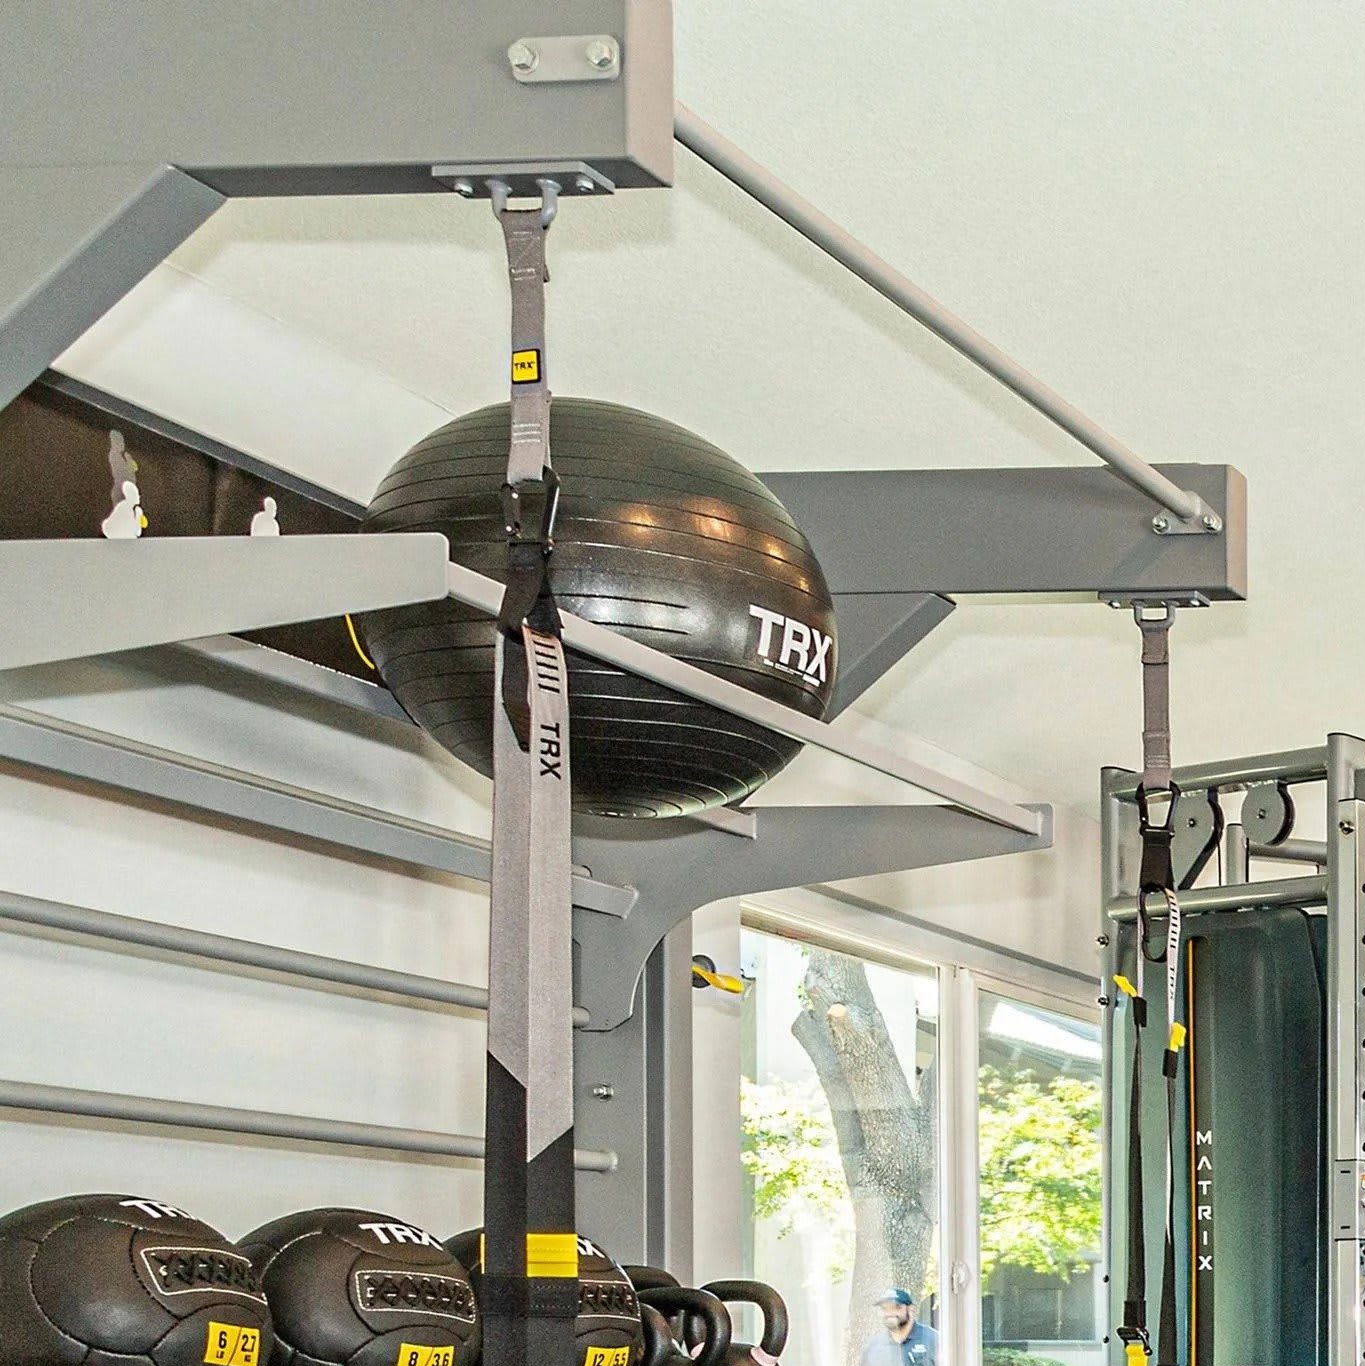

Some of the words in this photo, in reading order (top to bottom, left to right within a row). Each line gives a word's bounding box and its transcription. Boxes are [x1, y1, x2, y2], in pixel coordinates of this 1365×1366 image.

[514, 361, 534, 371] TRX
[749, 604, 832, 683] TRX
[540, 722, 562, 781] TRX
[1196, 1130, 1213, 1271] MATRIX
[358, 1223, 444, 1251] TRX
[218, 1331, 228, 1349] 6
[241, 1334, 256, 1353] 2.7
[408, 1351, 419, 1366] 8
